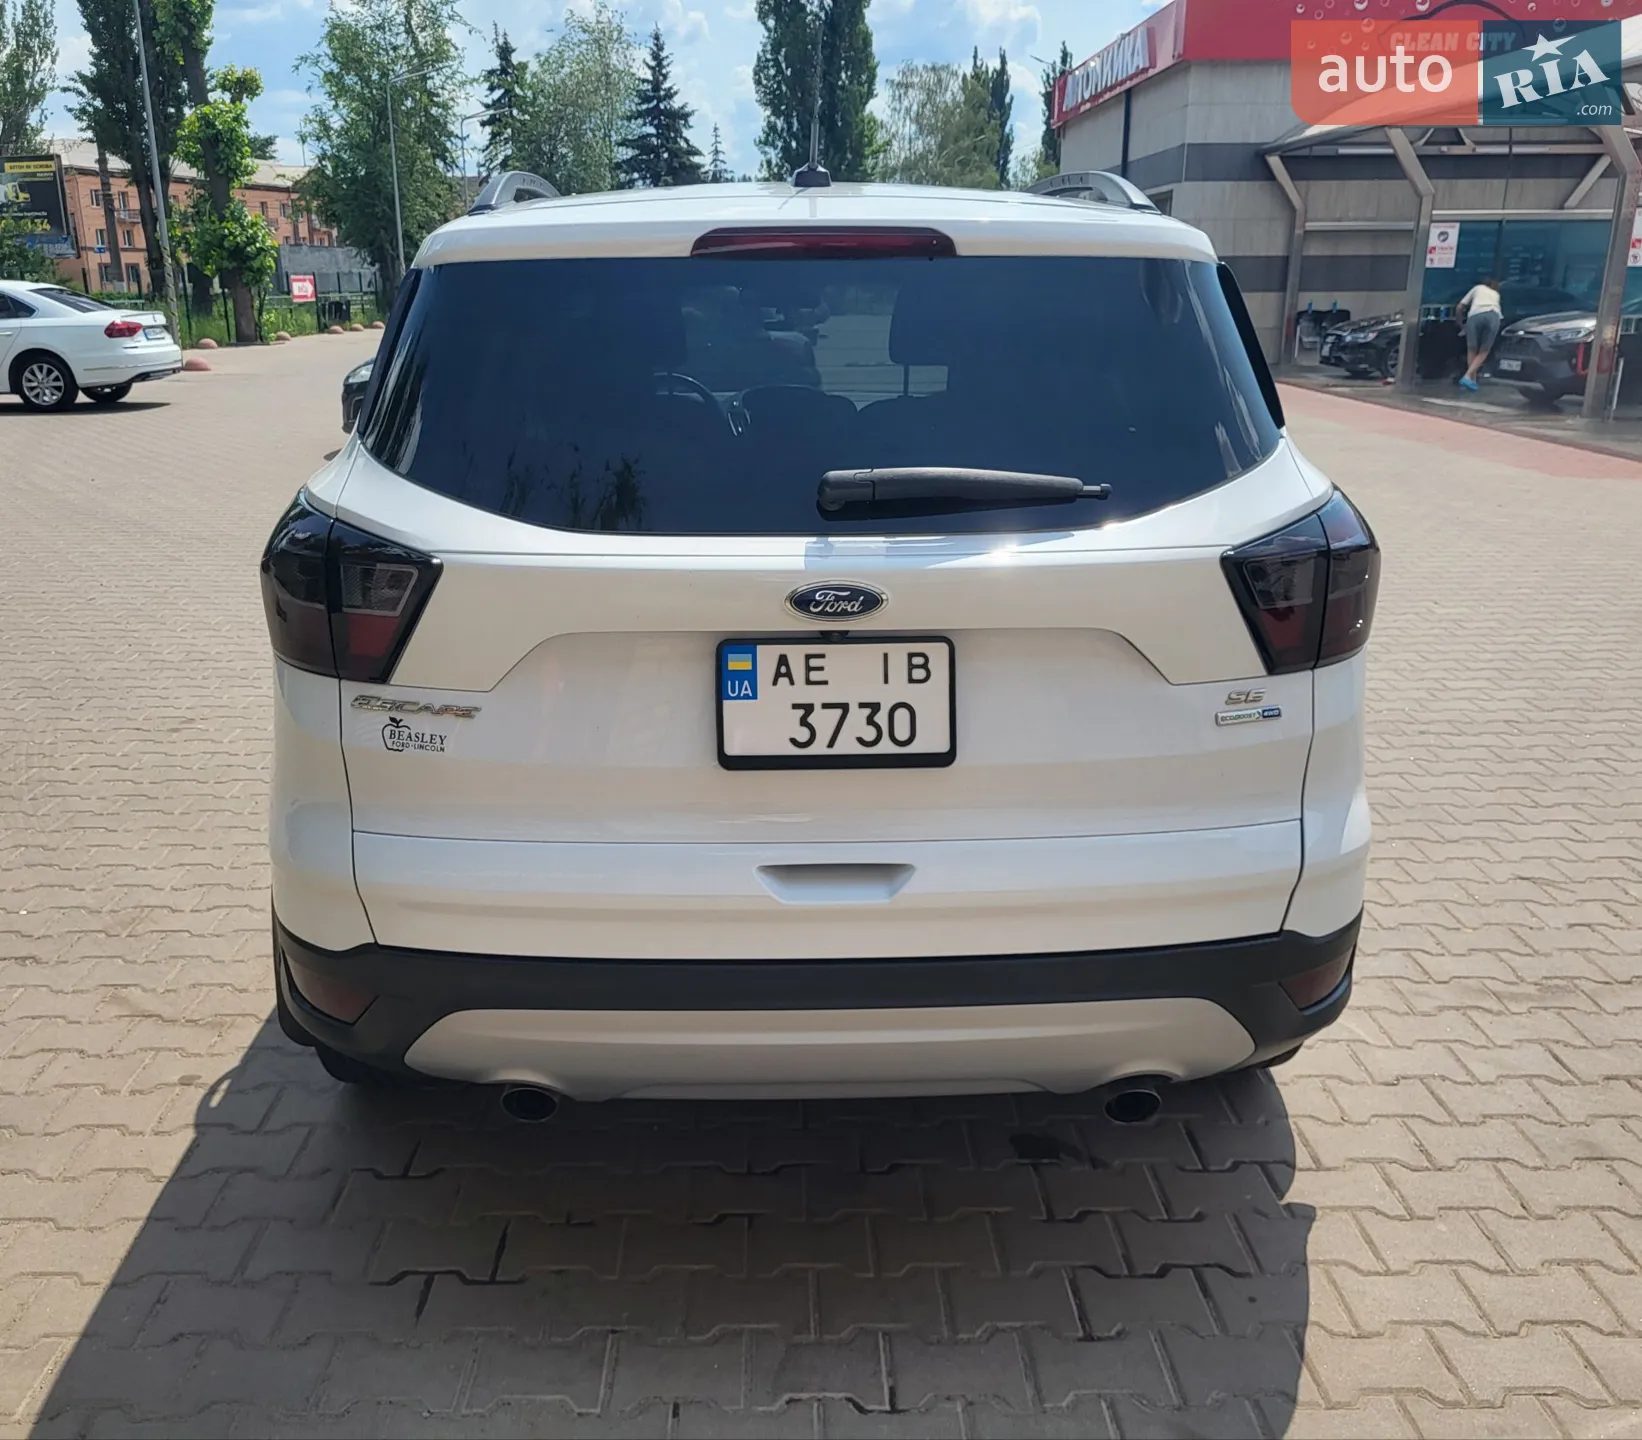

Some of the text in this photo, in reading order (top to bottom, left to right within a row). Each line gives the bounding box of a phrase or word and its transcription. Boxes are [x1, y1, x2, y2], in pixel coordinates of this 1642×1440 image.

[1390, 32, 1516, 51] CLEAN CITY
[1063, 27, 1148, 112] АТОМИЙКА
[809, 590, 863, 613] Ford
[772, 652, 932, 687] AE IB
[728, 680, 753, 697] UA
[1225, 688, 1267, 705] SE
[351, 694, 482, 720] ESCAPE
[788, 701, 917, 749] 3730
[389, 729, 447, 746] BEASLEY
